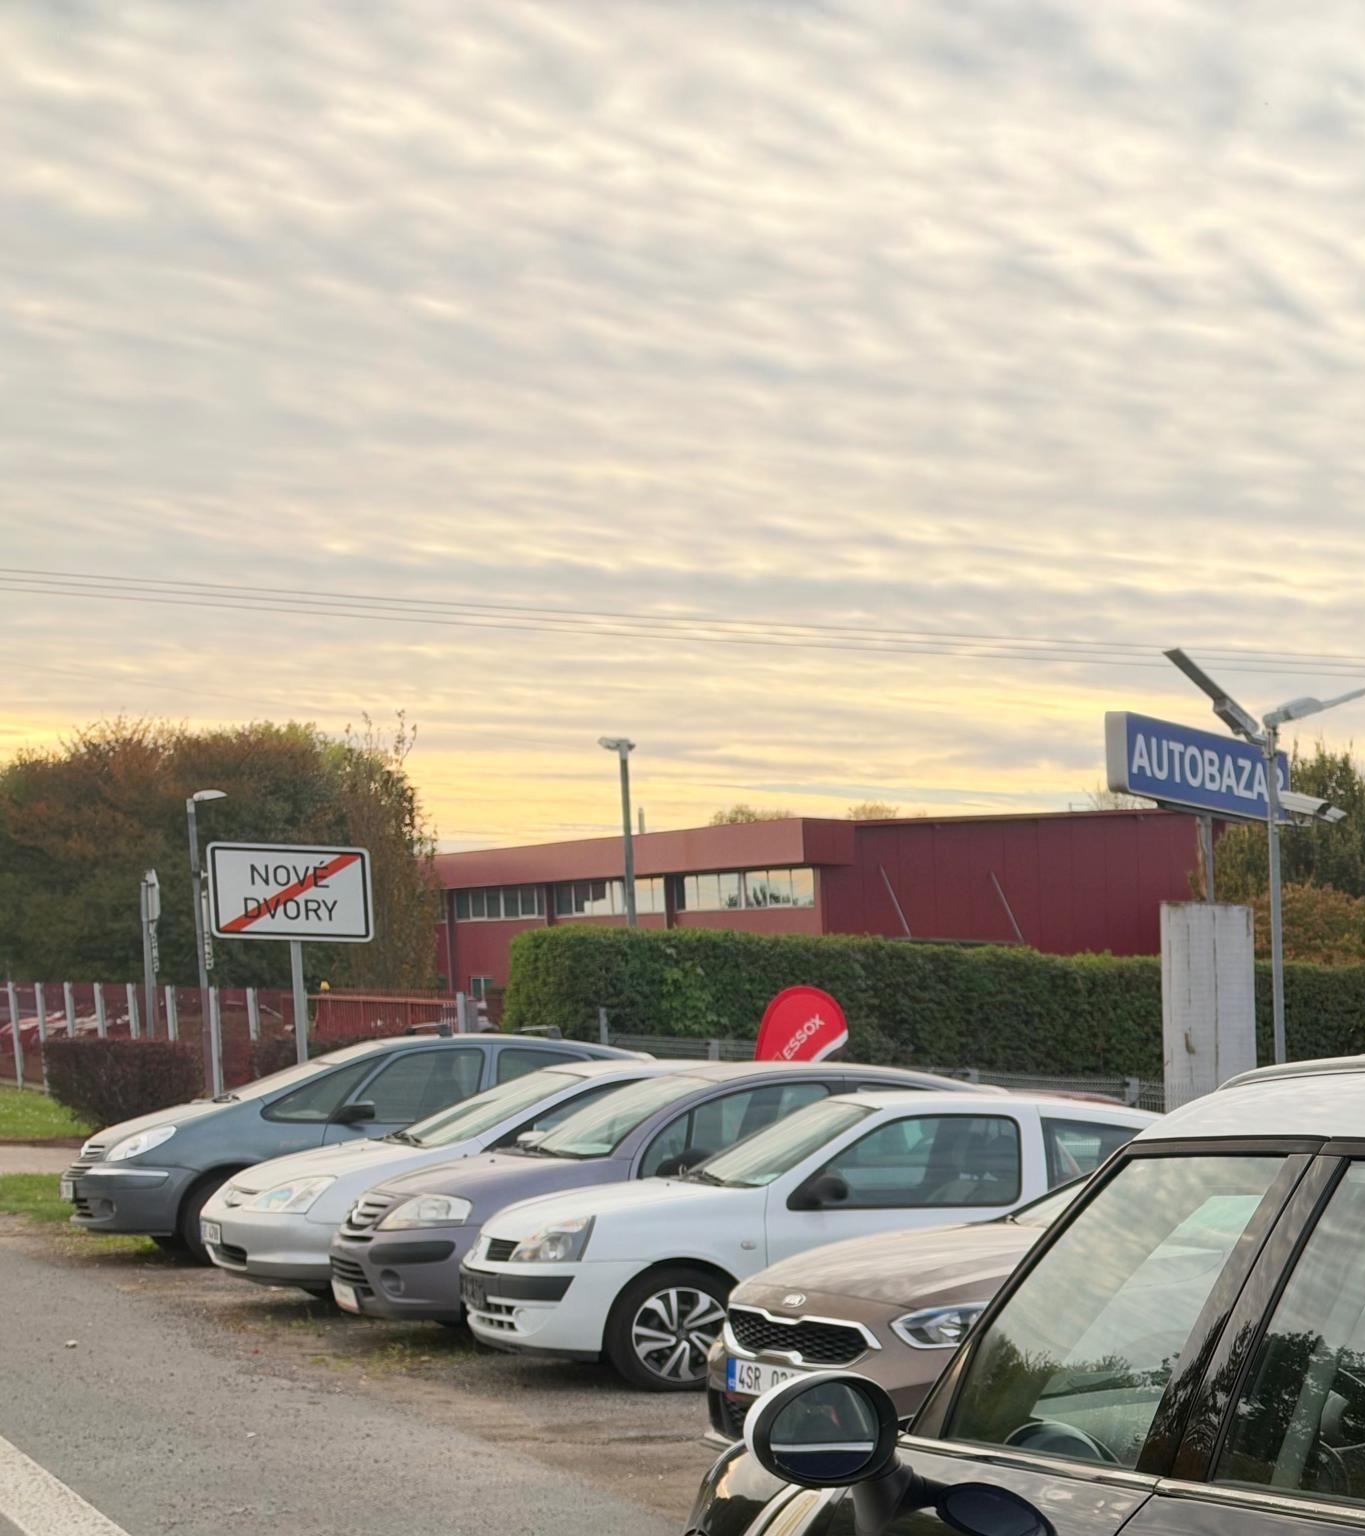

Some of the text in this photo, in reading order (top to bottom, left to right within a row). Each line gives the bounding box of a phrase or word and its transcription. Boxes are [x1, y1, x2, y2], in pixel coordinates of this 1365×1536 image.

[250, 860, 330, 888] NOVÉ
[243, 897, 338, 921] DVORY
[782, 1013, 825, 1060] ESSOX
[739, 1365, 762, 1391] 4SR
